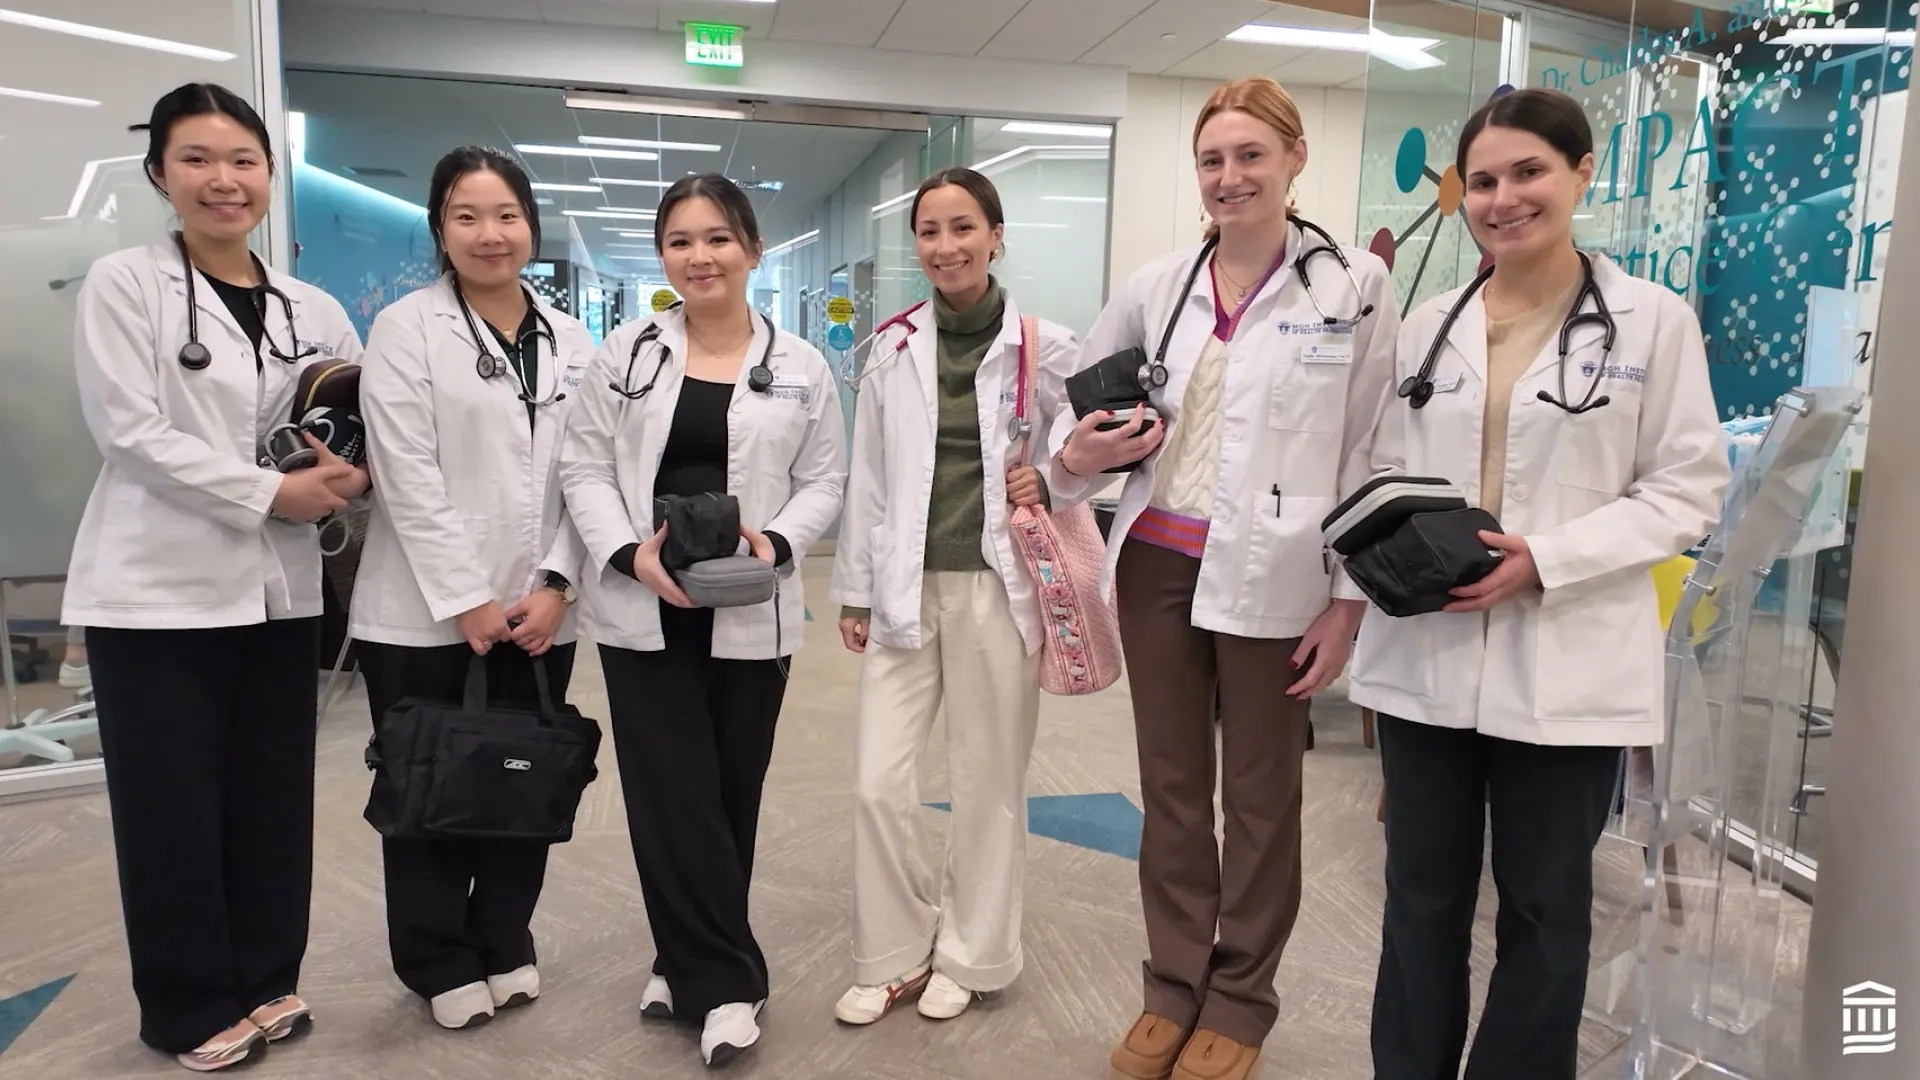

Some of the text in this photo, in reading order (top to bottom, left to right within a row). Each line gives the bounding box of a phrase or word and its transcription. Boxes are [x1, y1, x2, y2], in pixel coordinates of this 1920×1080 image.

[696, 27, 735, 60] EXIT
[1681, 7, 1717, 52] A.
[1586, 50, 1888, 204] MPACT
